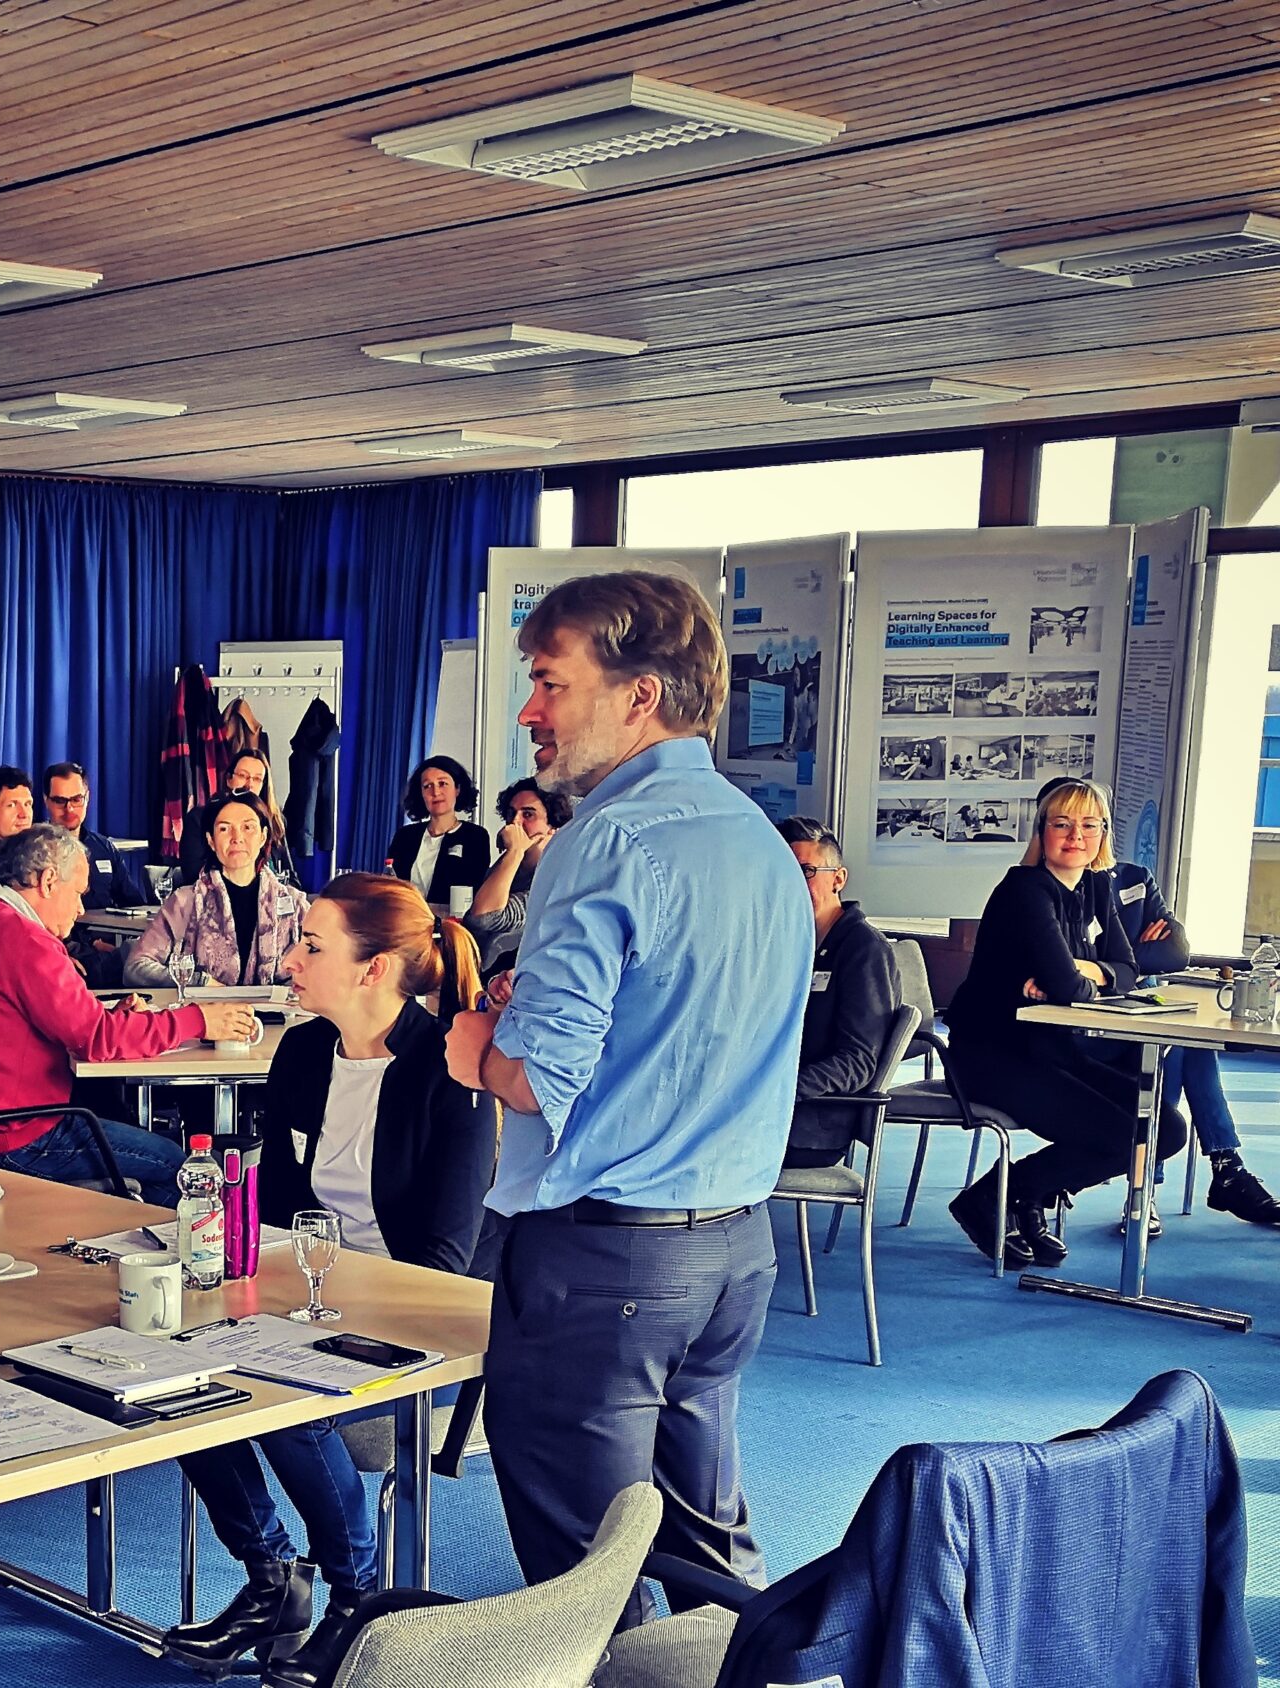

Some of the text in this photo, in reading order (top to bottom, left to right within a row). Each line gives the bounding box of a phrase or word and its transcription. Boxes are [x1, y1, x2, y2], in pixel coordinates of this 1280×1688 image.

[888, 610, 997, 622] Learning Spaces for
[887, 623, 989, 634] Digitally Enhanced
[887, 634, 1009, 647] Teaching and Learning
